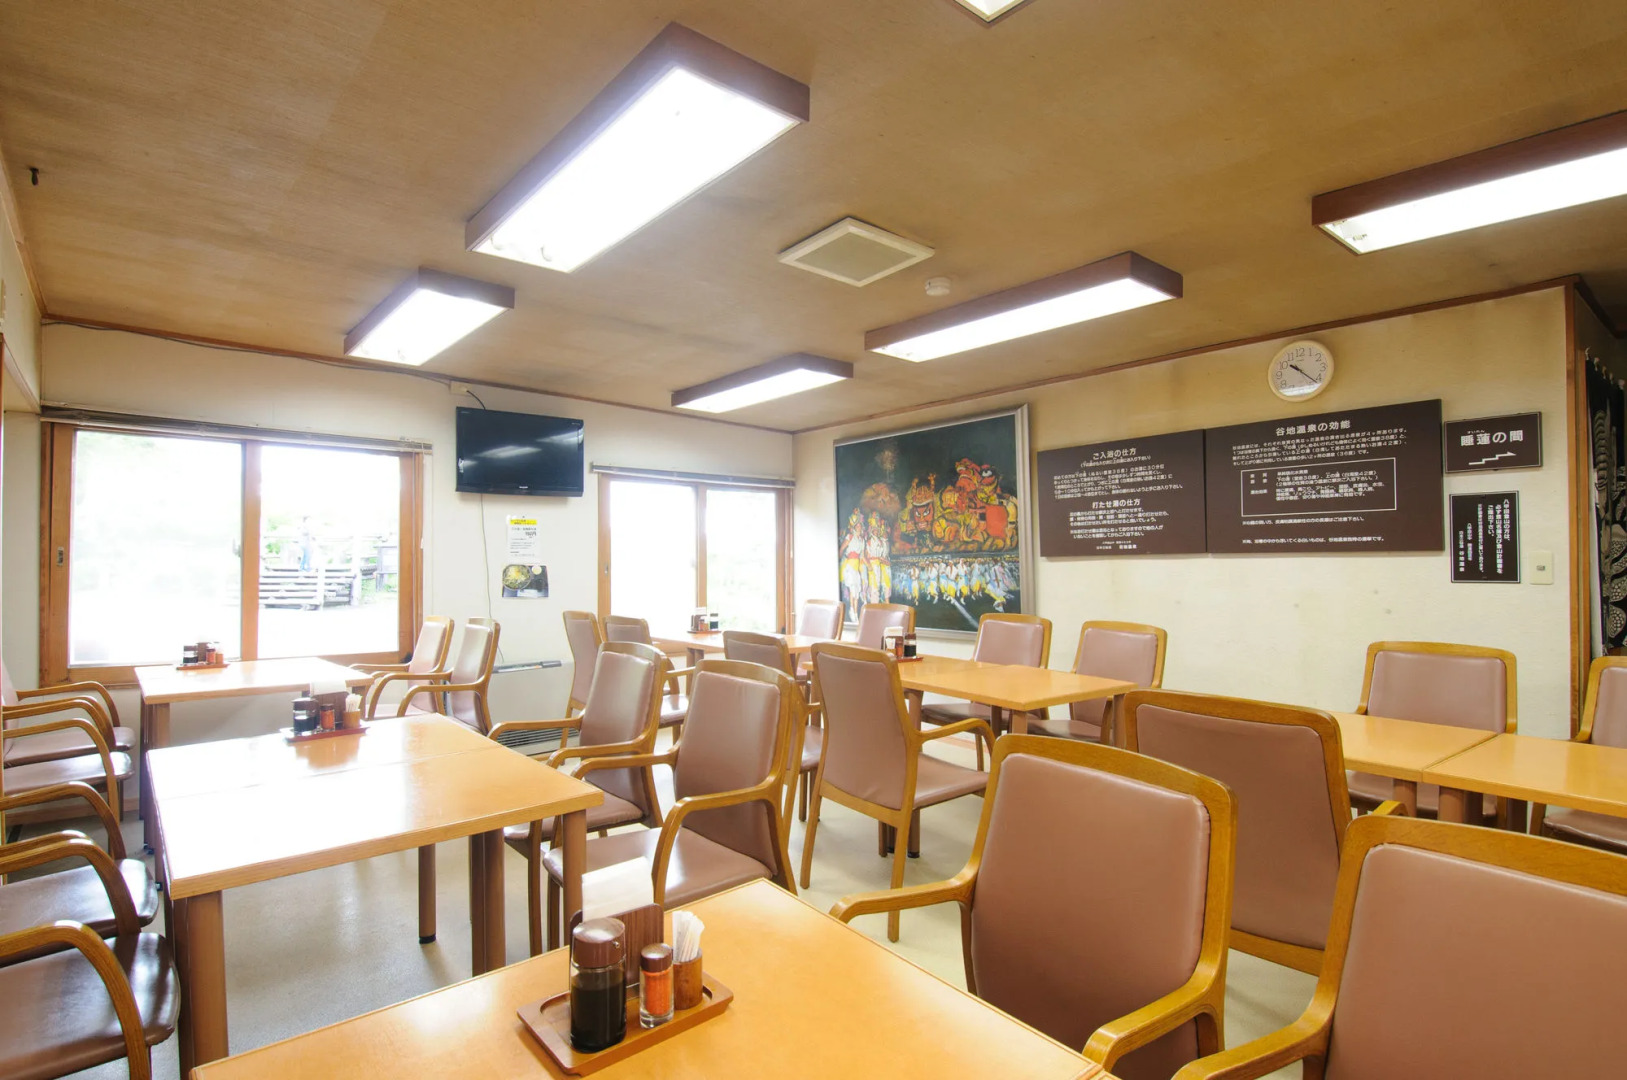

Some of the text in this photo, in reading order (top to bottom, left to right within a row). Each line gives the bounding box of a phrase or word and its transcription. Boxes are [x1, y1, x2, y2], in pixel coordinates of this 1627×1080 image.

[1275, 420, 1351, 437] 谷地温泉の効能
[1460, 430, 1524, 447] 睡蓮の間
[1092, 499, 1141, 509] 打たせ湯の仕方
